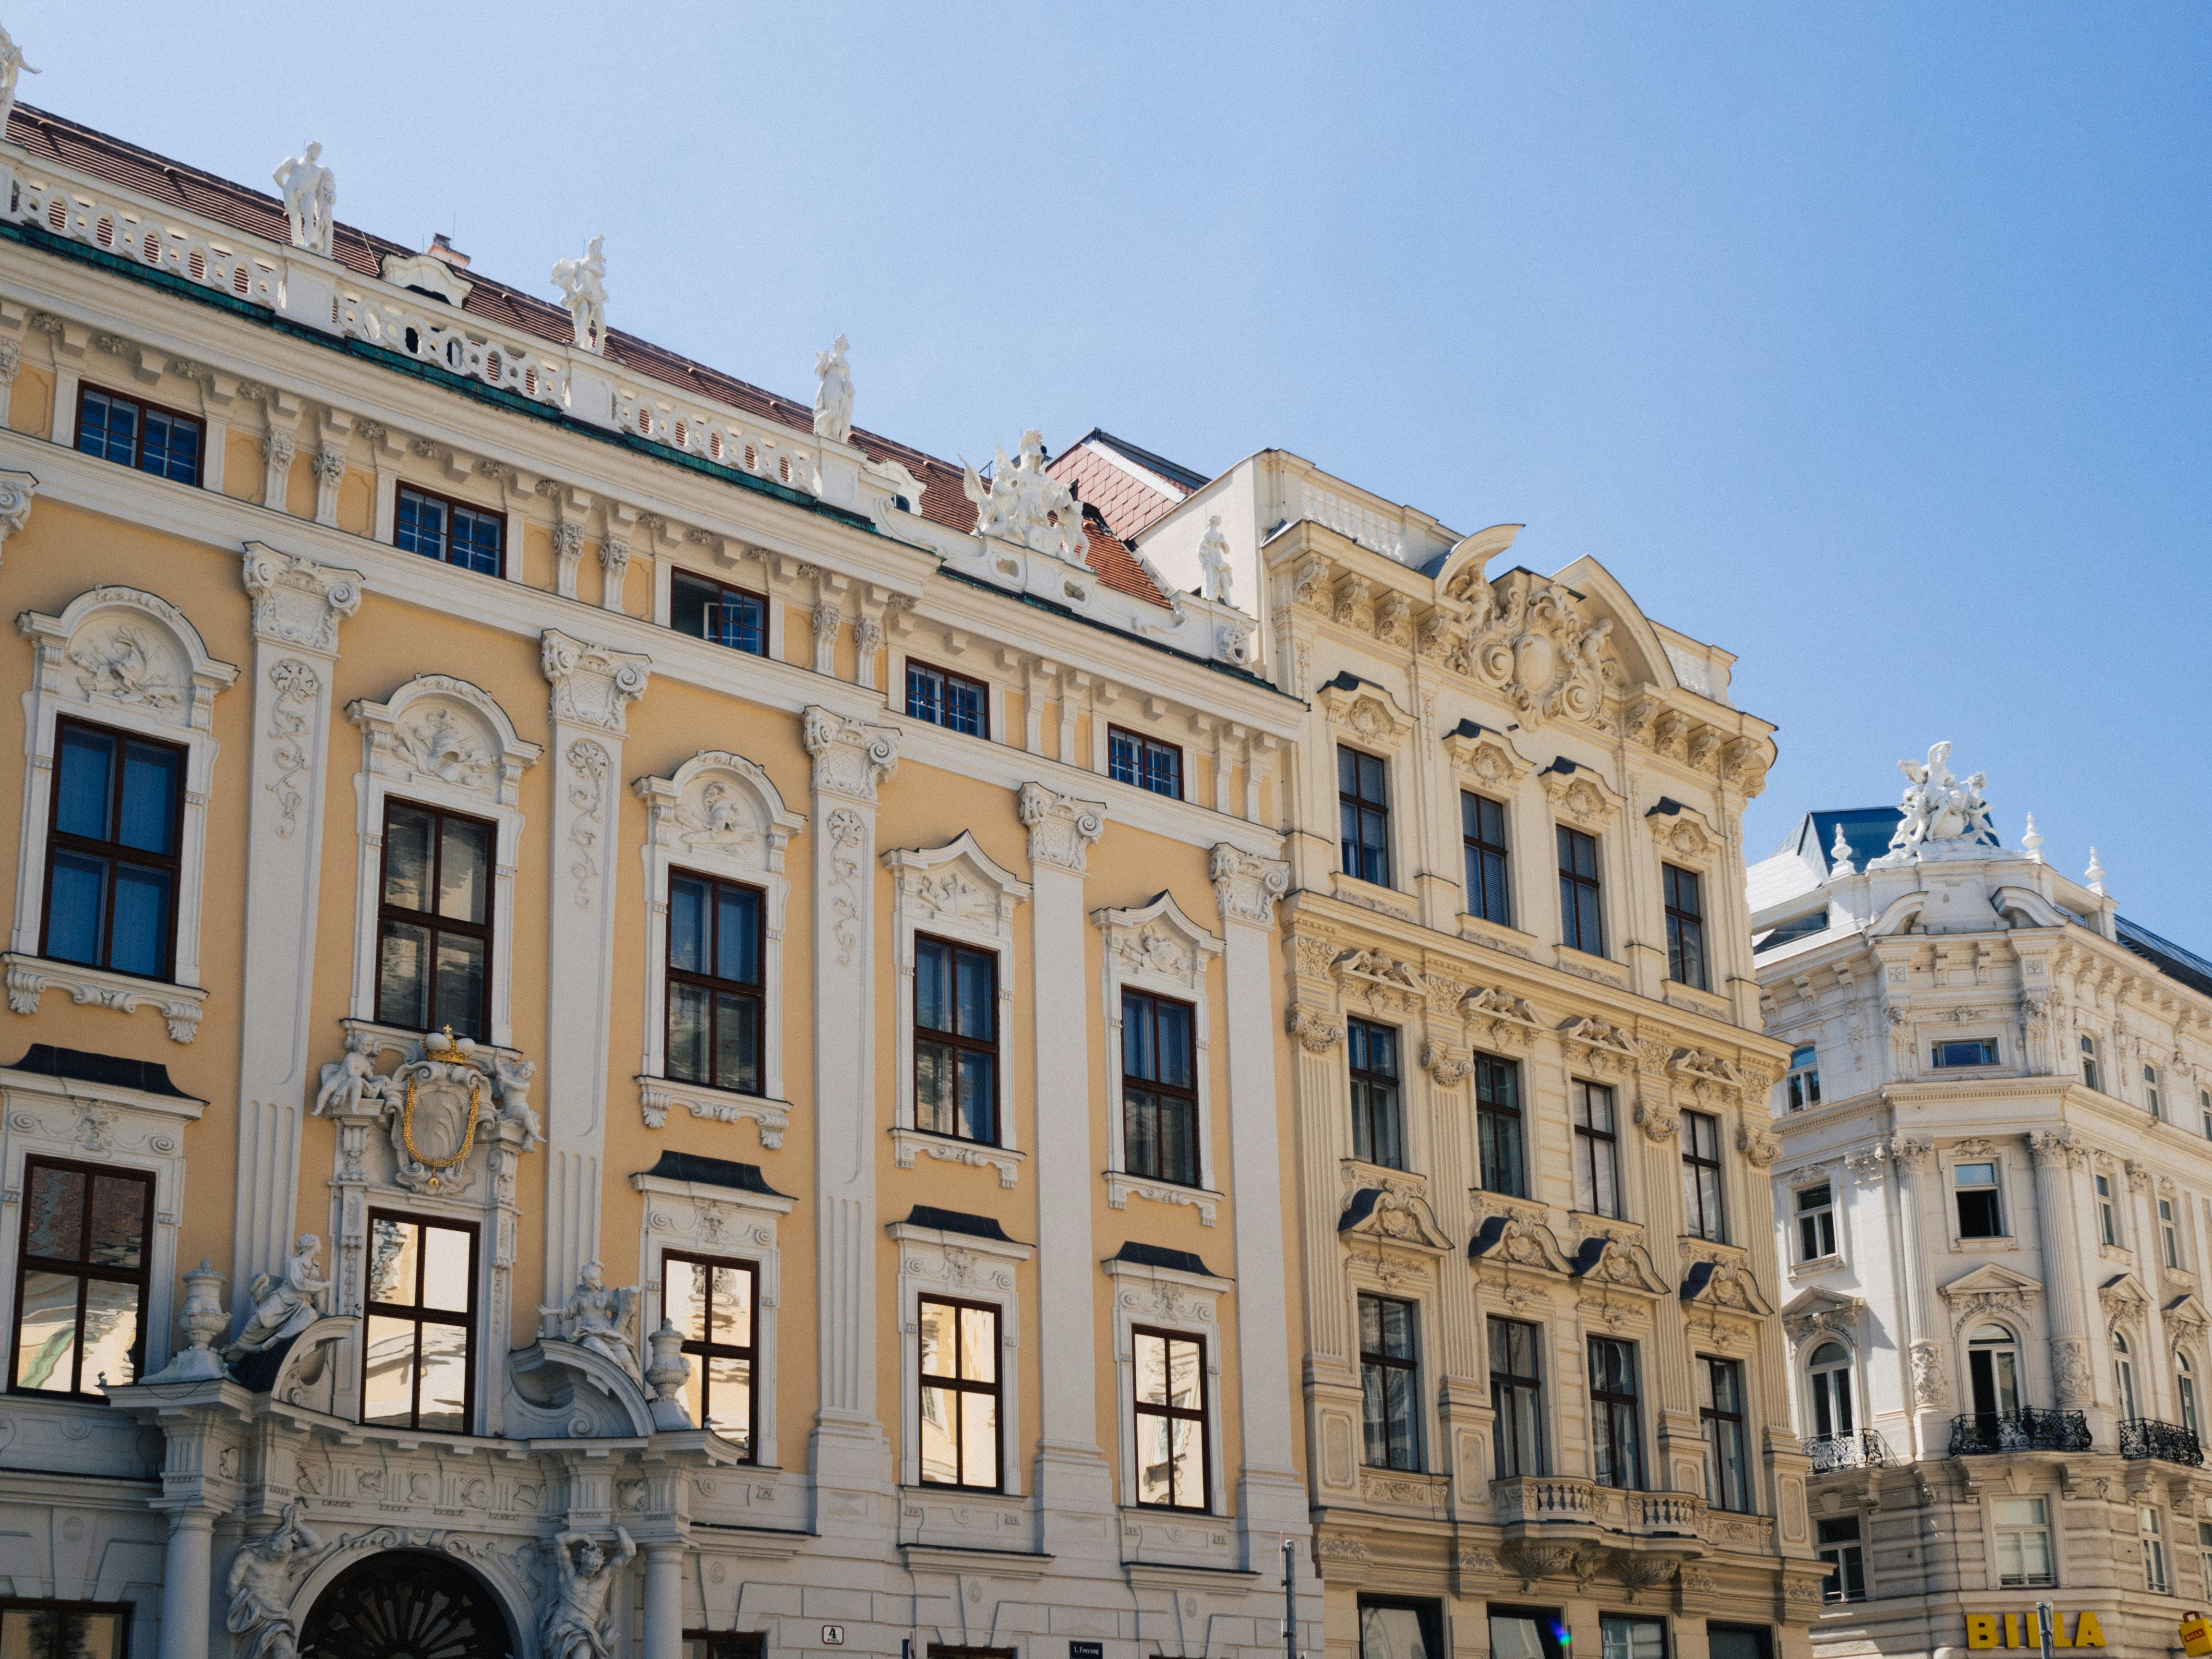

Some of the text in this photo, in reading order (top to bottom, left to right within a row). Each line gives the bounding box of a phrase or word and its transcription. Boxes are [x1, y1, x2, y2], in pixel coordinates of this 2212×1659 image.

[829, 1627, 837, 1639] 4
[2185, 1630, 2204, 1641] BILLA
[1080, 1646, 1099, 1655] Freyung
